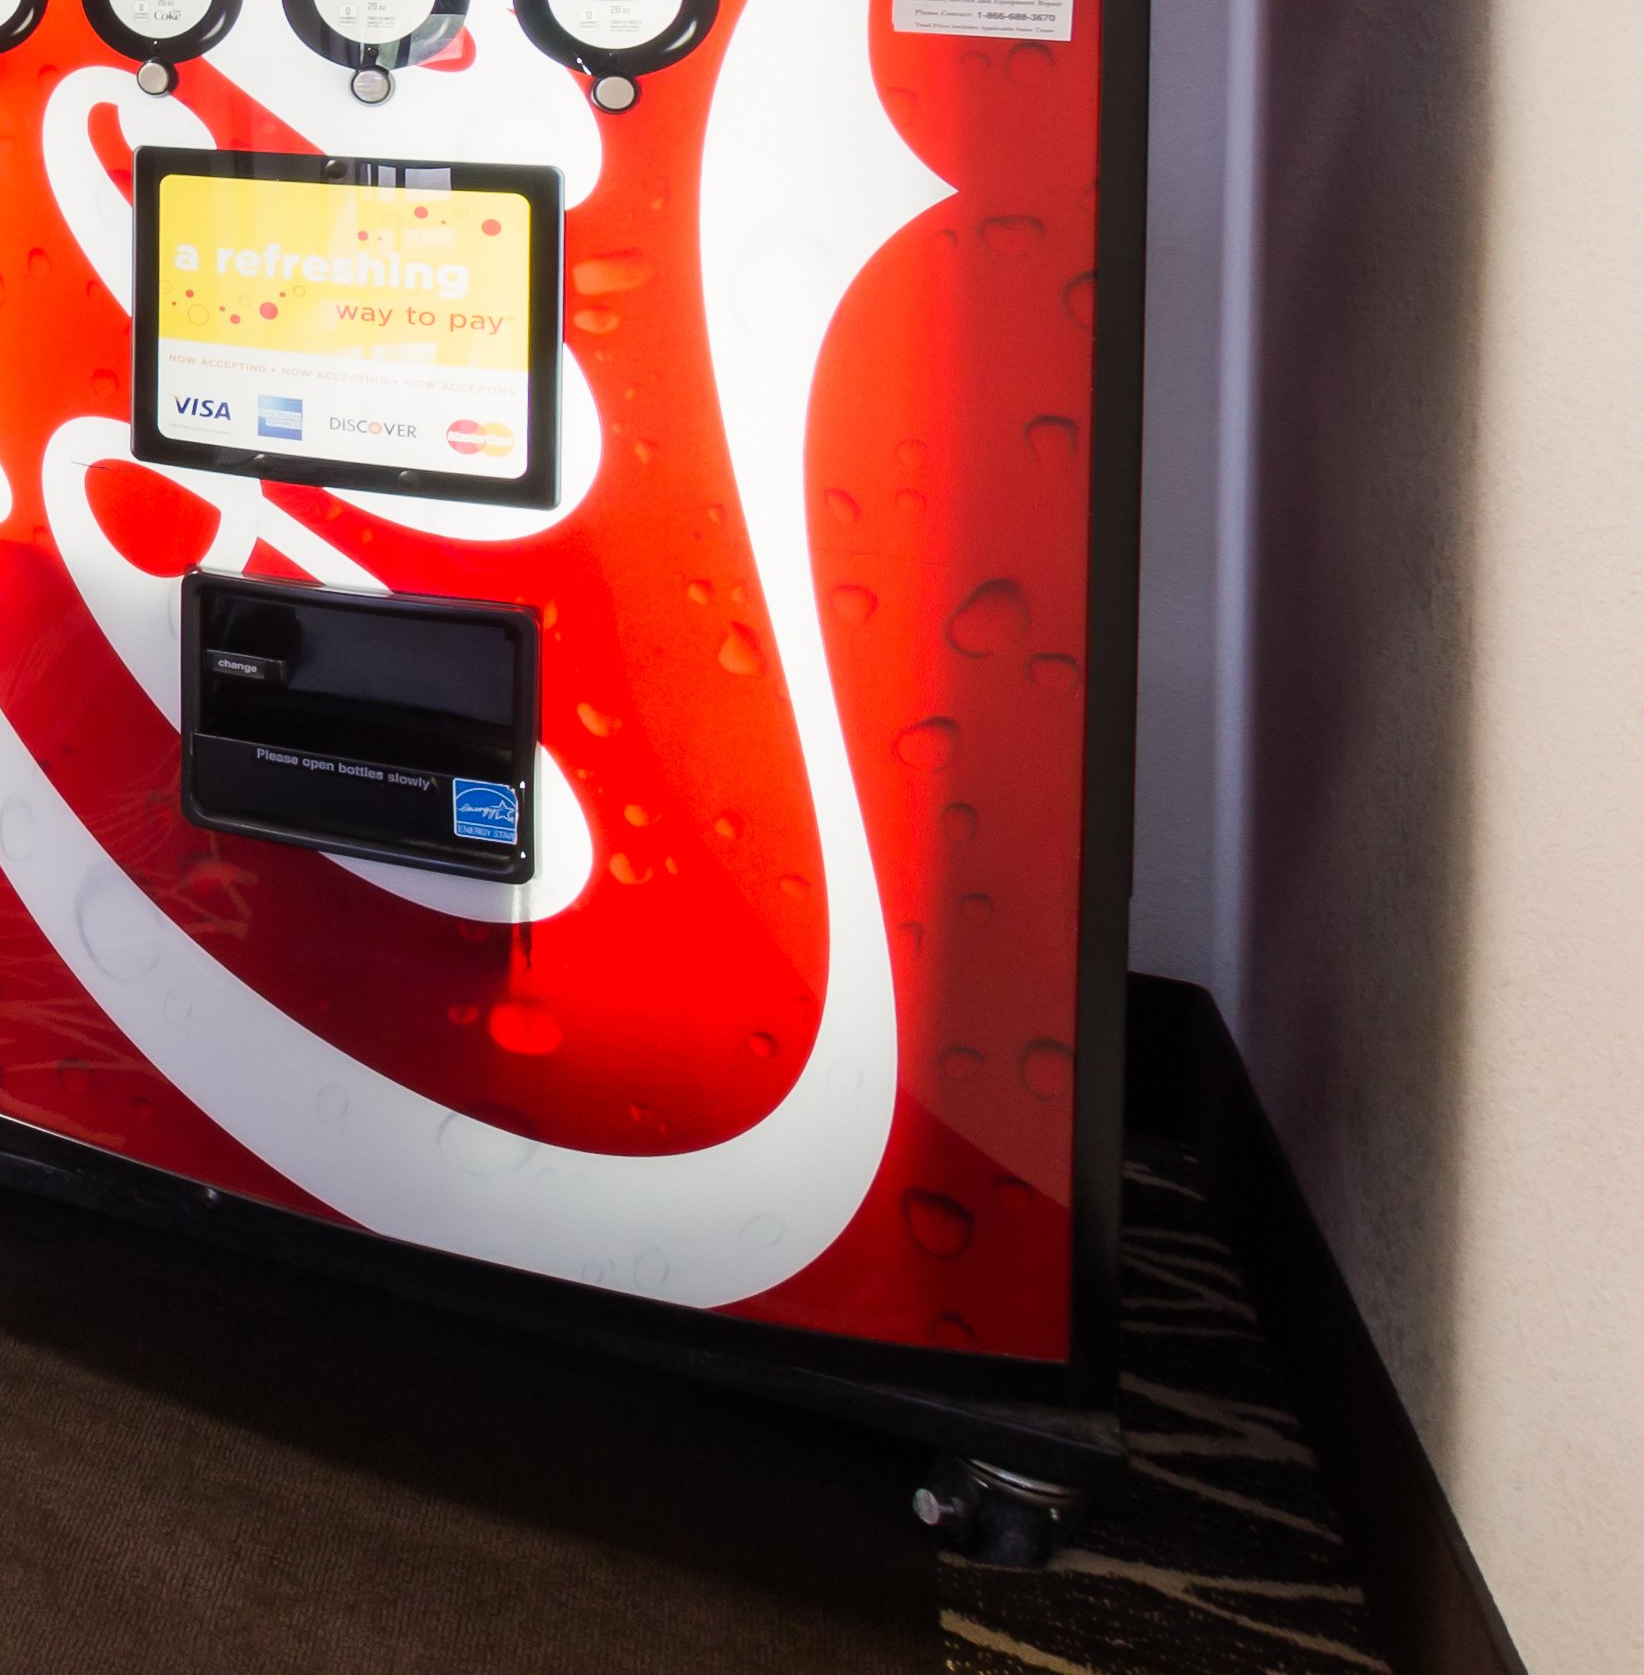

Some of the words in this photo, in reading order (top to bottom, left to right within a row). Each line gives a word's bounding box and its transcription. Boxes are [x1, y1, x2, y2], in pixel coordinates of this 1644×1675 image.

[174, 243, 199, 273] a
[217, 240, 469, 301] refreshing
[335, 304, 393, 328] way
[406, 306, 436, 327] to
[449, 312, 504, 336] pay
[173, 394, 232, 422] VISA
[330, 417, 417, 439] DISCOVER
[218, 658, 257, 674] change
[257, 748, 299, 766] Please
[302, 757, 334, 773] open
[338, 762, 383, 780] bottles
[387, 772, 431, 792] slowly
